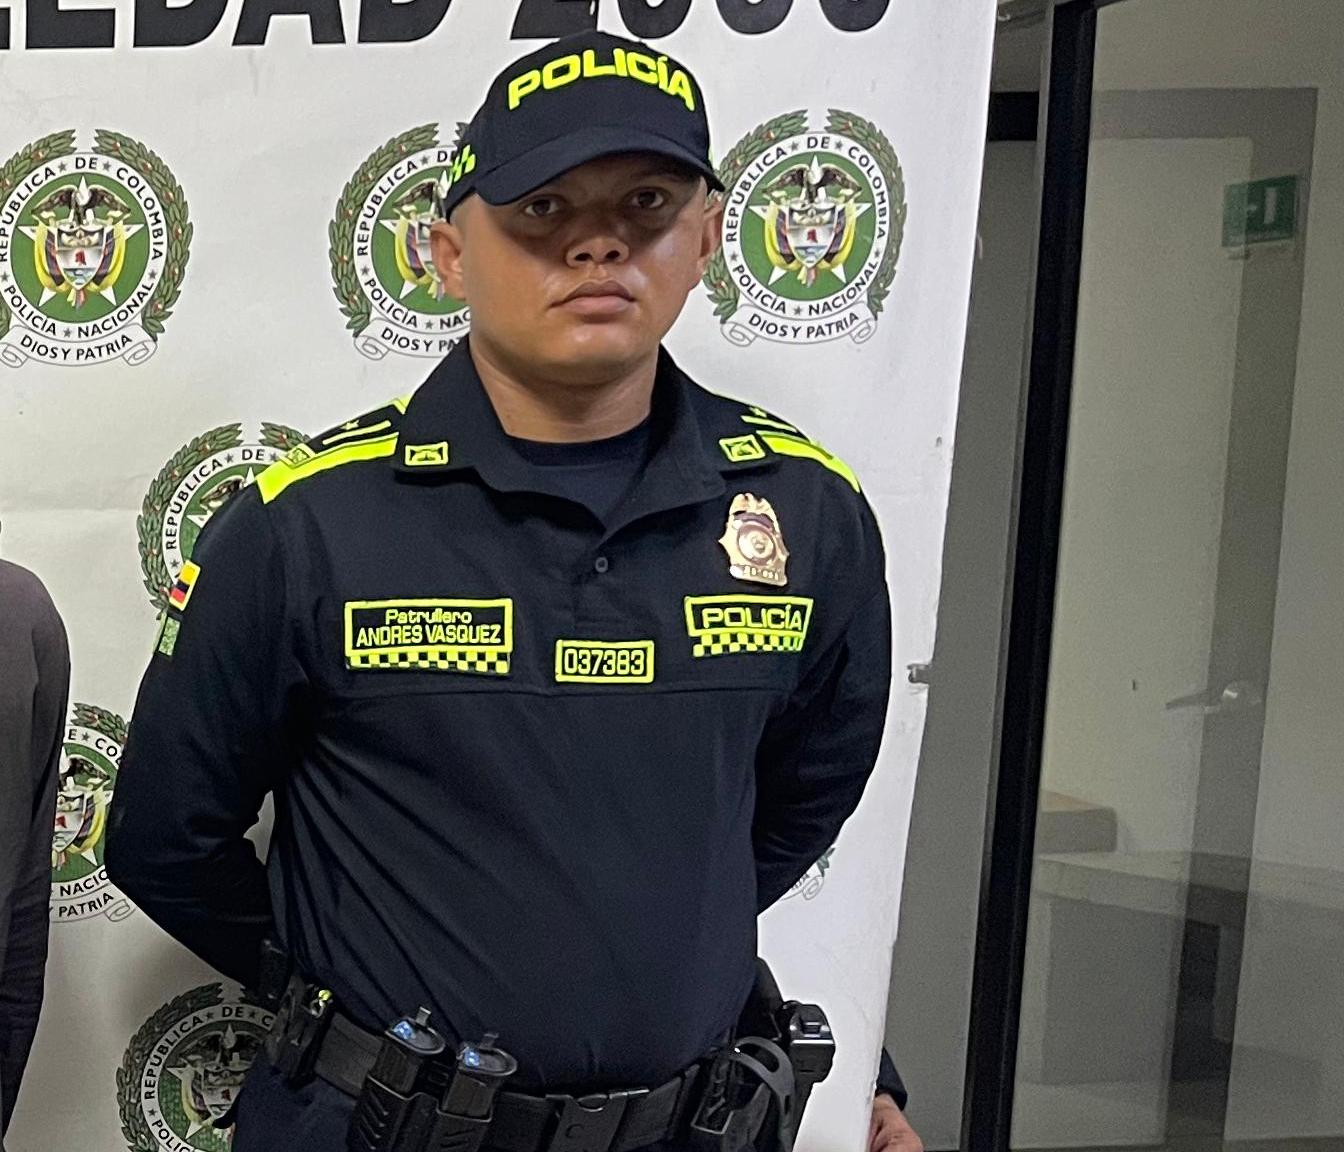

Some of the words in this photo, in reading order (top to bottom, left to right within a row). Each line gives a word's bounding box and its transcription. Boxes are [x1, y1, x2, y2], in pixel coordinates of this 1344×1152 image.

[508, 48, 695, 111] POLICÍA
[807, 136, 830, 149] DE
[849, 146, 887, 238] COLOMBIA
[75, 156, 98, 170] DE
[116, 167, 164, 260] COLOMBIA
[808, 261, 878, 316] NACIONAL
[77, 283, 154, 337] NACIONAL
[806, 312, 859, 338] PATRIA
[76, 334, 132, 361] PATRIA
[242, 448, 264, 461] DE
[385, 608, 472, 625] Patrullero
[702, 605, 802, 631] POLICÍA
[356, 625, 423, 648] ANDRES
[425, 624, 502, 644] VASQUEZ
[564, 648, 645, 676] 037383
[59, 892, 113, 917] PATRIA
